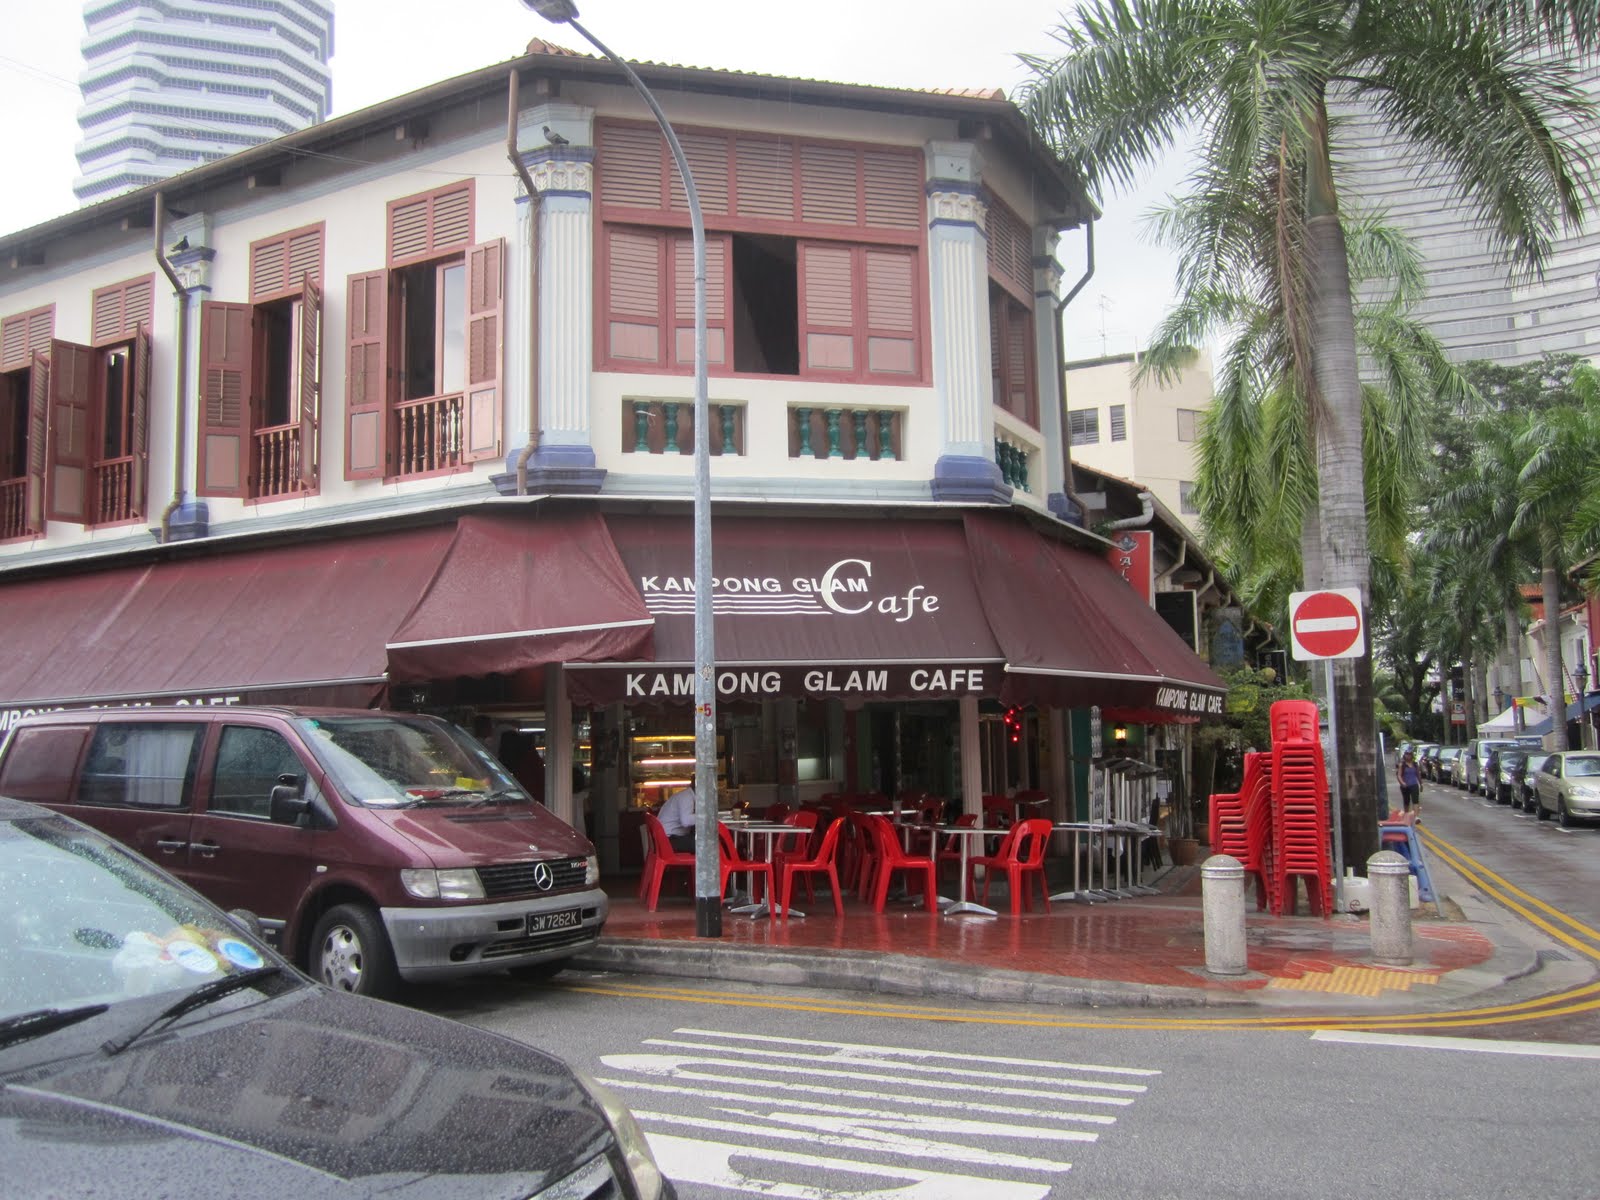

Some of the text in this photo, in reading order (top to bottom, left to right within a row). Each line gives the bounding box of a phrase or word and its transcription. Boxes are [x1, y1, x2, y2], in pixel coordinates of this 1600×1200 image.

[792, 578, 868, 592] GLAM
[821, 559, 940, 622] Cafe
[626, 669, 984, 696] KAMONG GLAM CAFE
[1190, 692, 1206, 712] GLAM
[1208, 695, 1222, 714] CAFE
